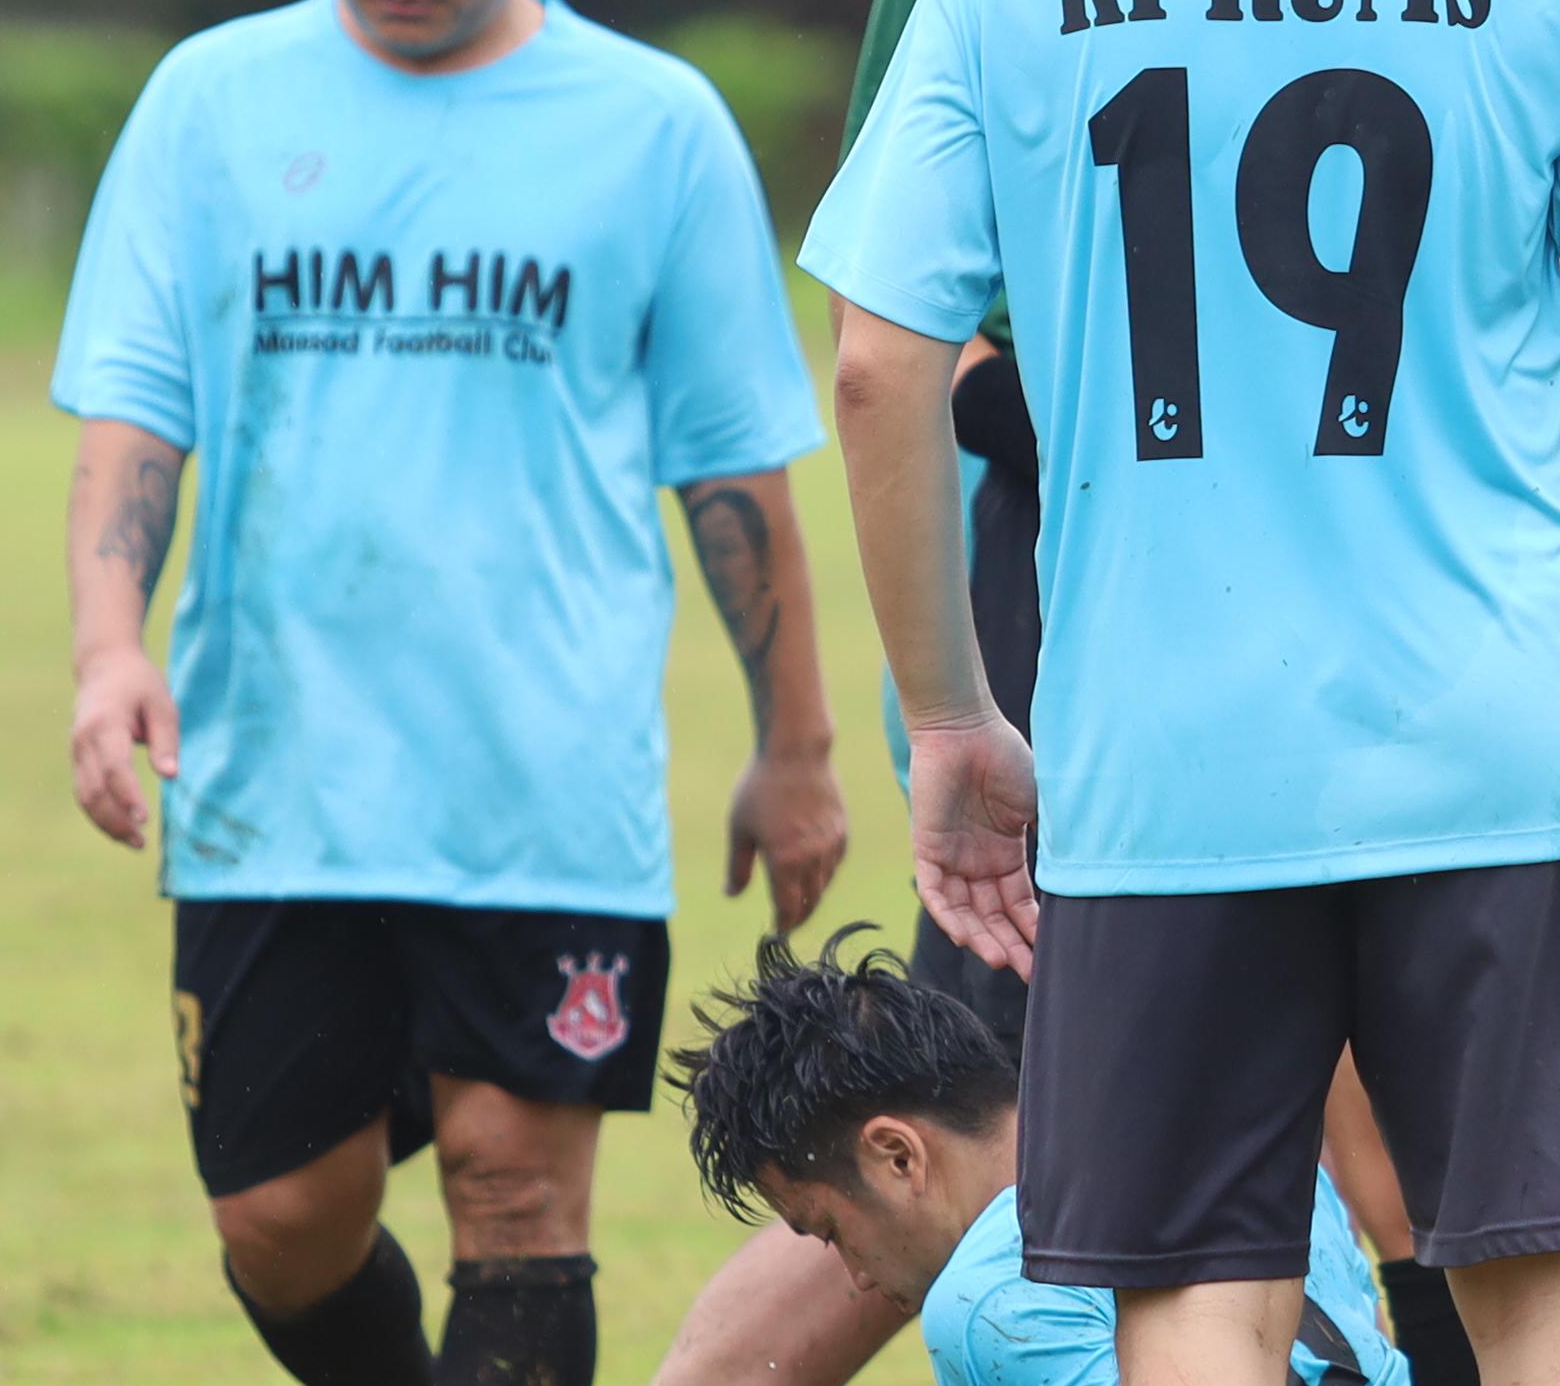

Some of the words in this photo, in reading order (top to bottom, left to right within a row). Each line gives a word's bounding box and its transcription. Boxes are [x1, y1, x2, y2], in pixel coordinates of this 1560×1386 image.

[254, 249, 394, 313] HIM
[430, 250, 573, 332] HIM
[1088, 67, 1434, 462] 19
